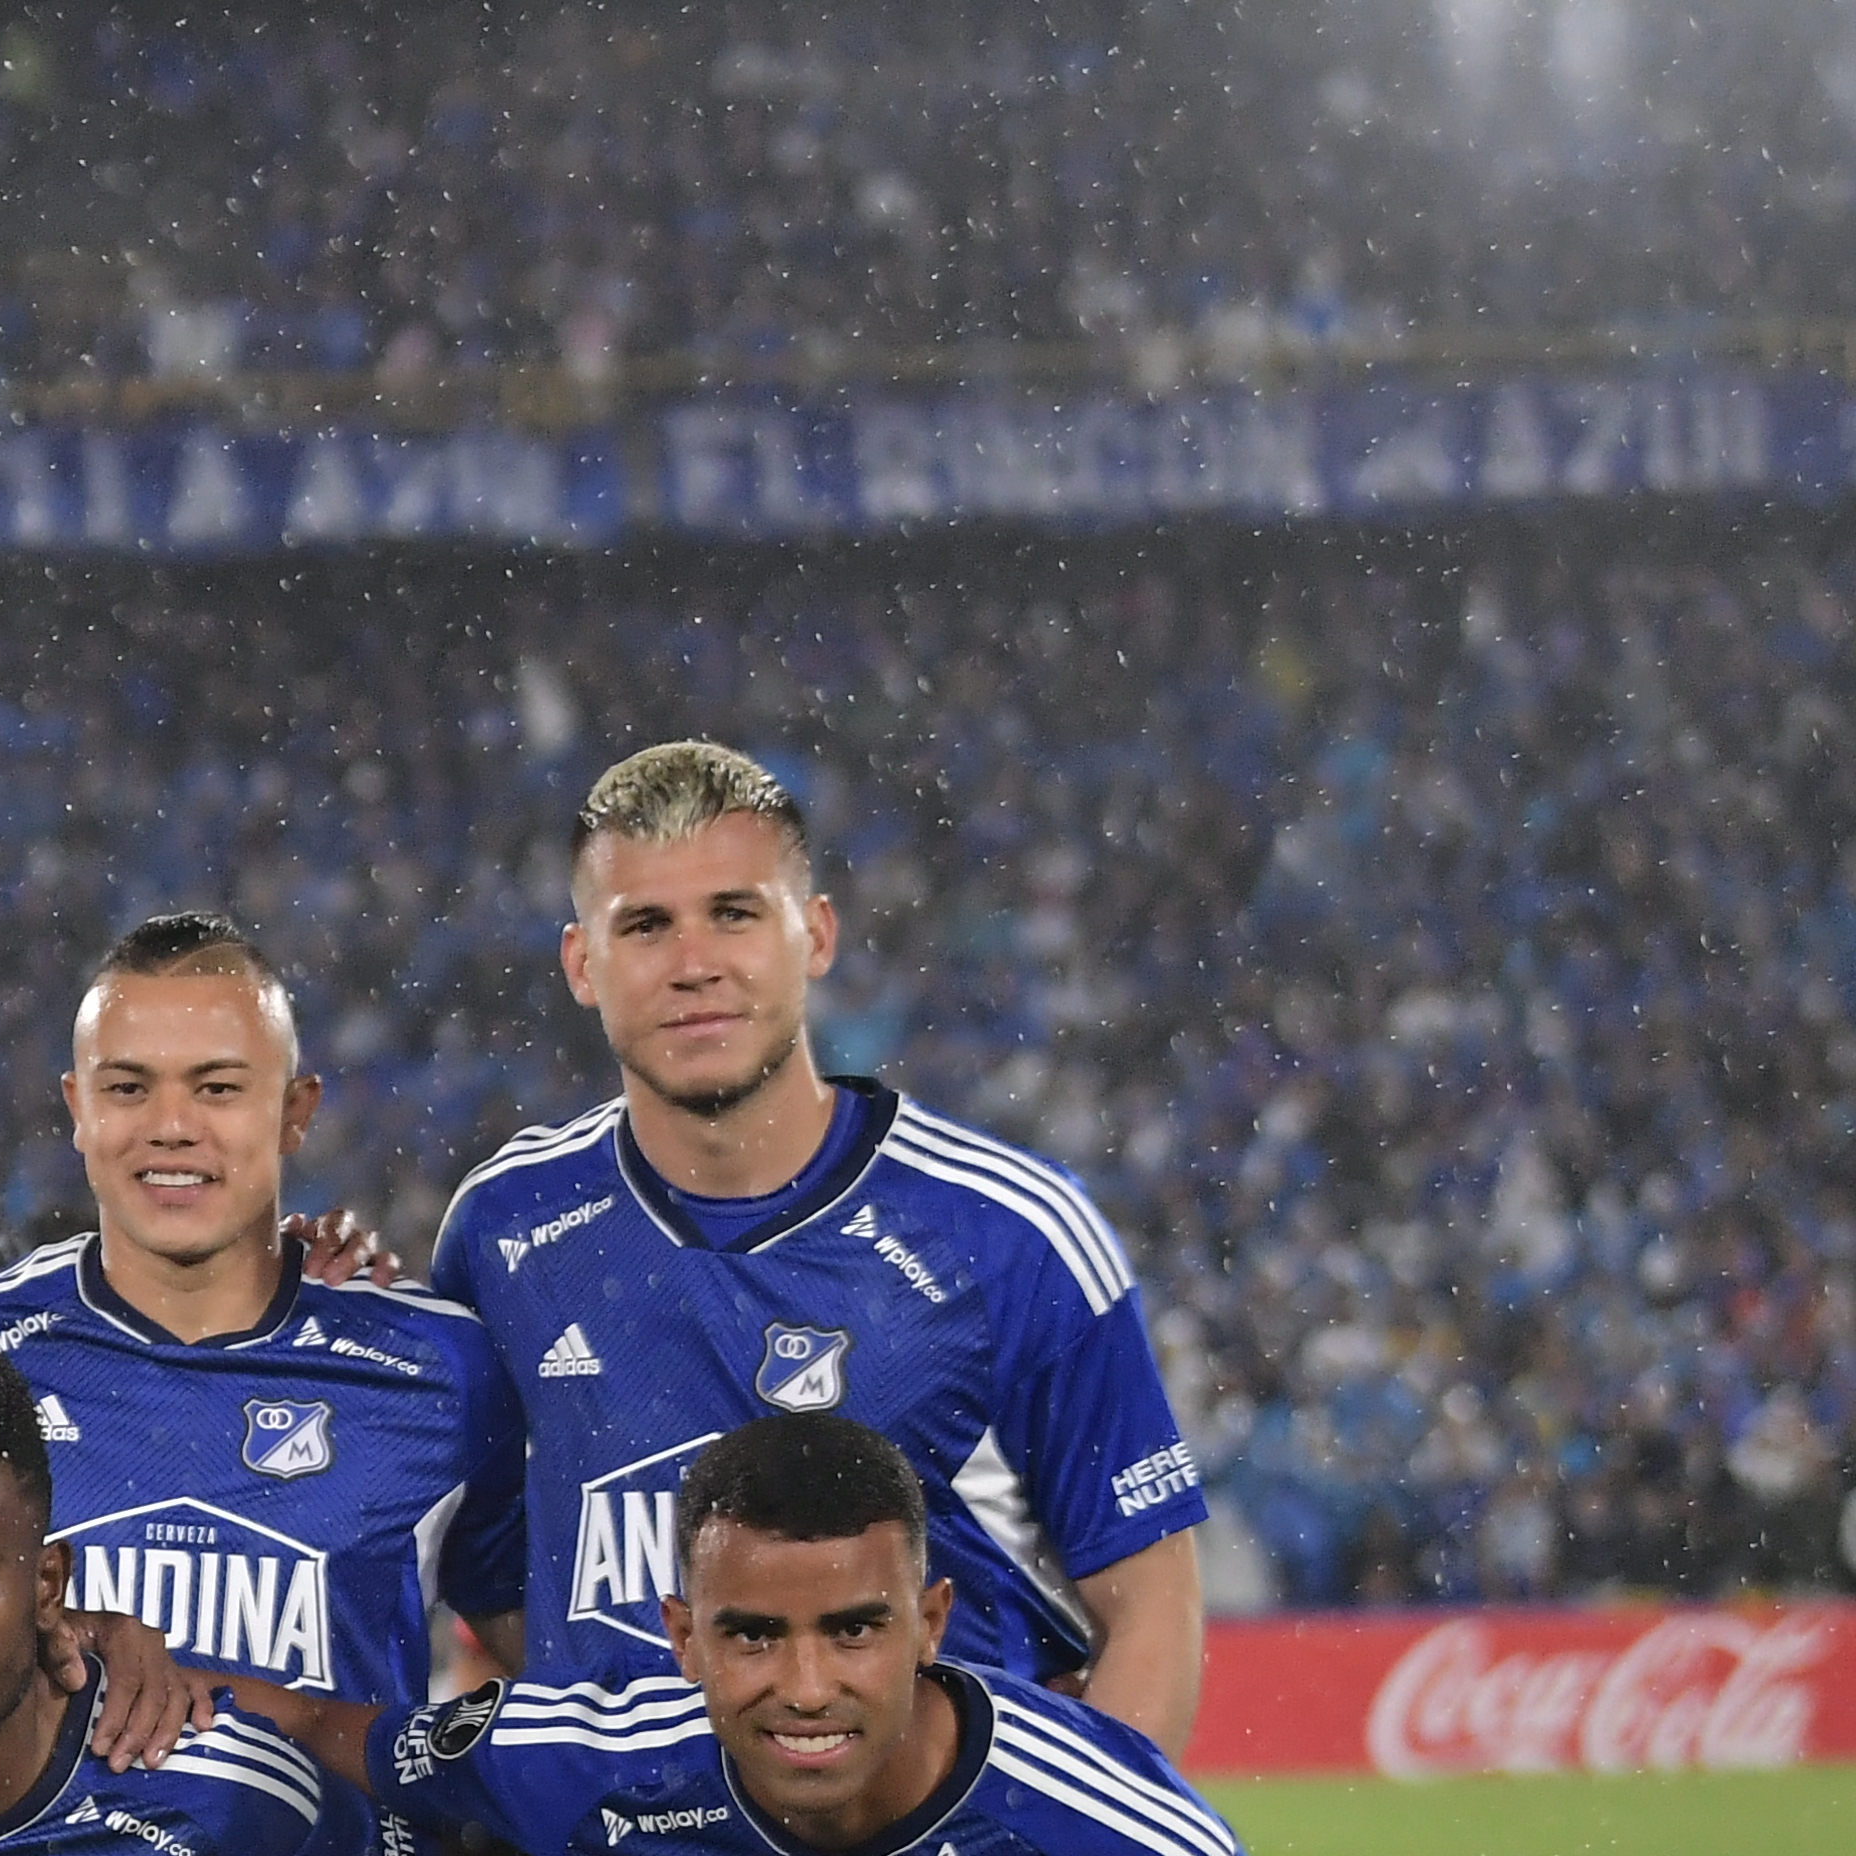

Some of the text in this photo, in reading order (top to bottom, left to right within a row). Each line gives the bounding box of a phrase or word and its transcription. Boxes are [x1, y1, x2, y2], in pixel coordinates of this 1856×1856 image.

[531, 1196, 613, 1247] Wplay.co
[874, 1235, 948, 1305] Wplay.co
[330, 1336, 422, 1376] Wplay.co
[538, 1358, 601, 1378] adidas
[146, 1522, 216, 1545] CERVEZA
[65, 1545, 330, 1680] NDINA
[637, 1806, 729, 1835] Wplay.co
